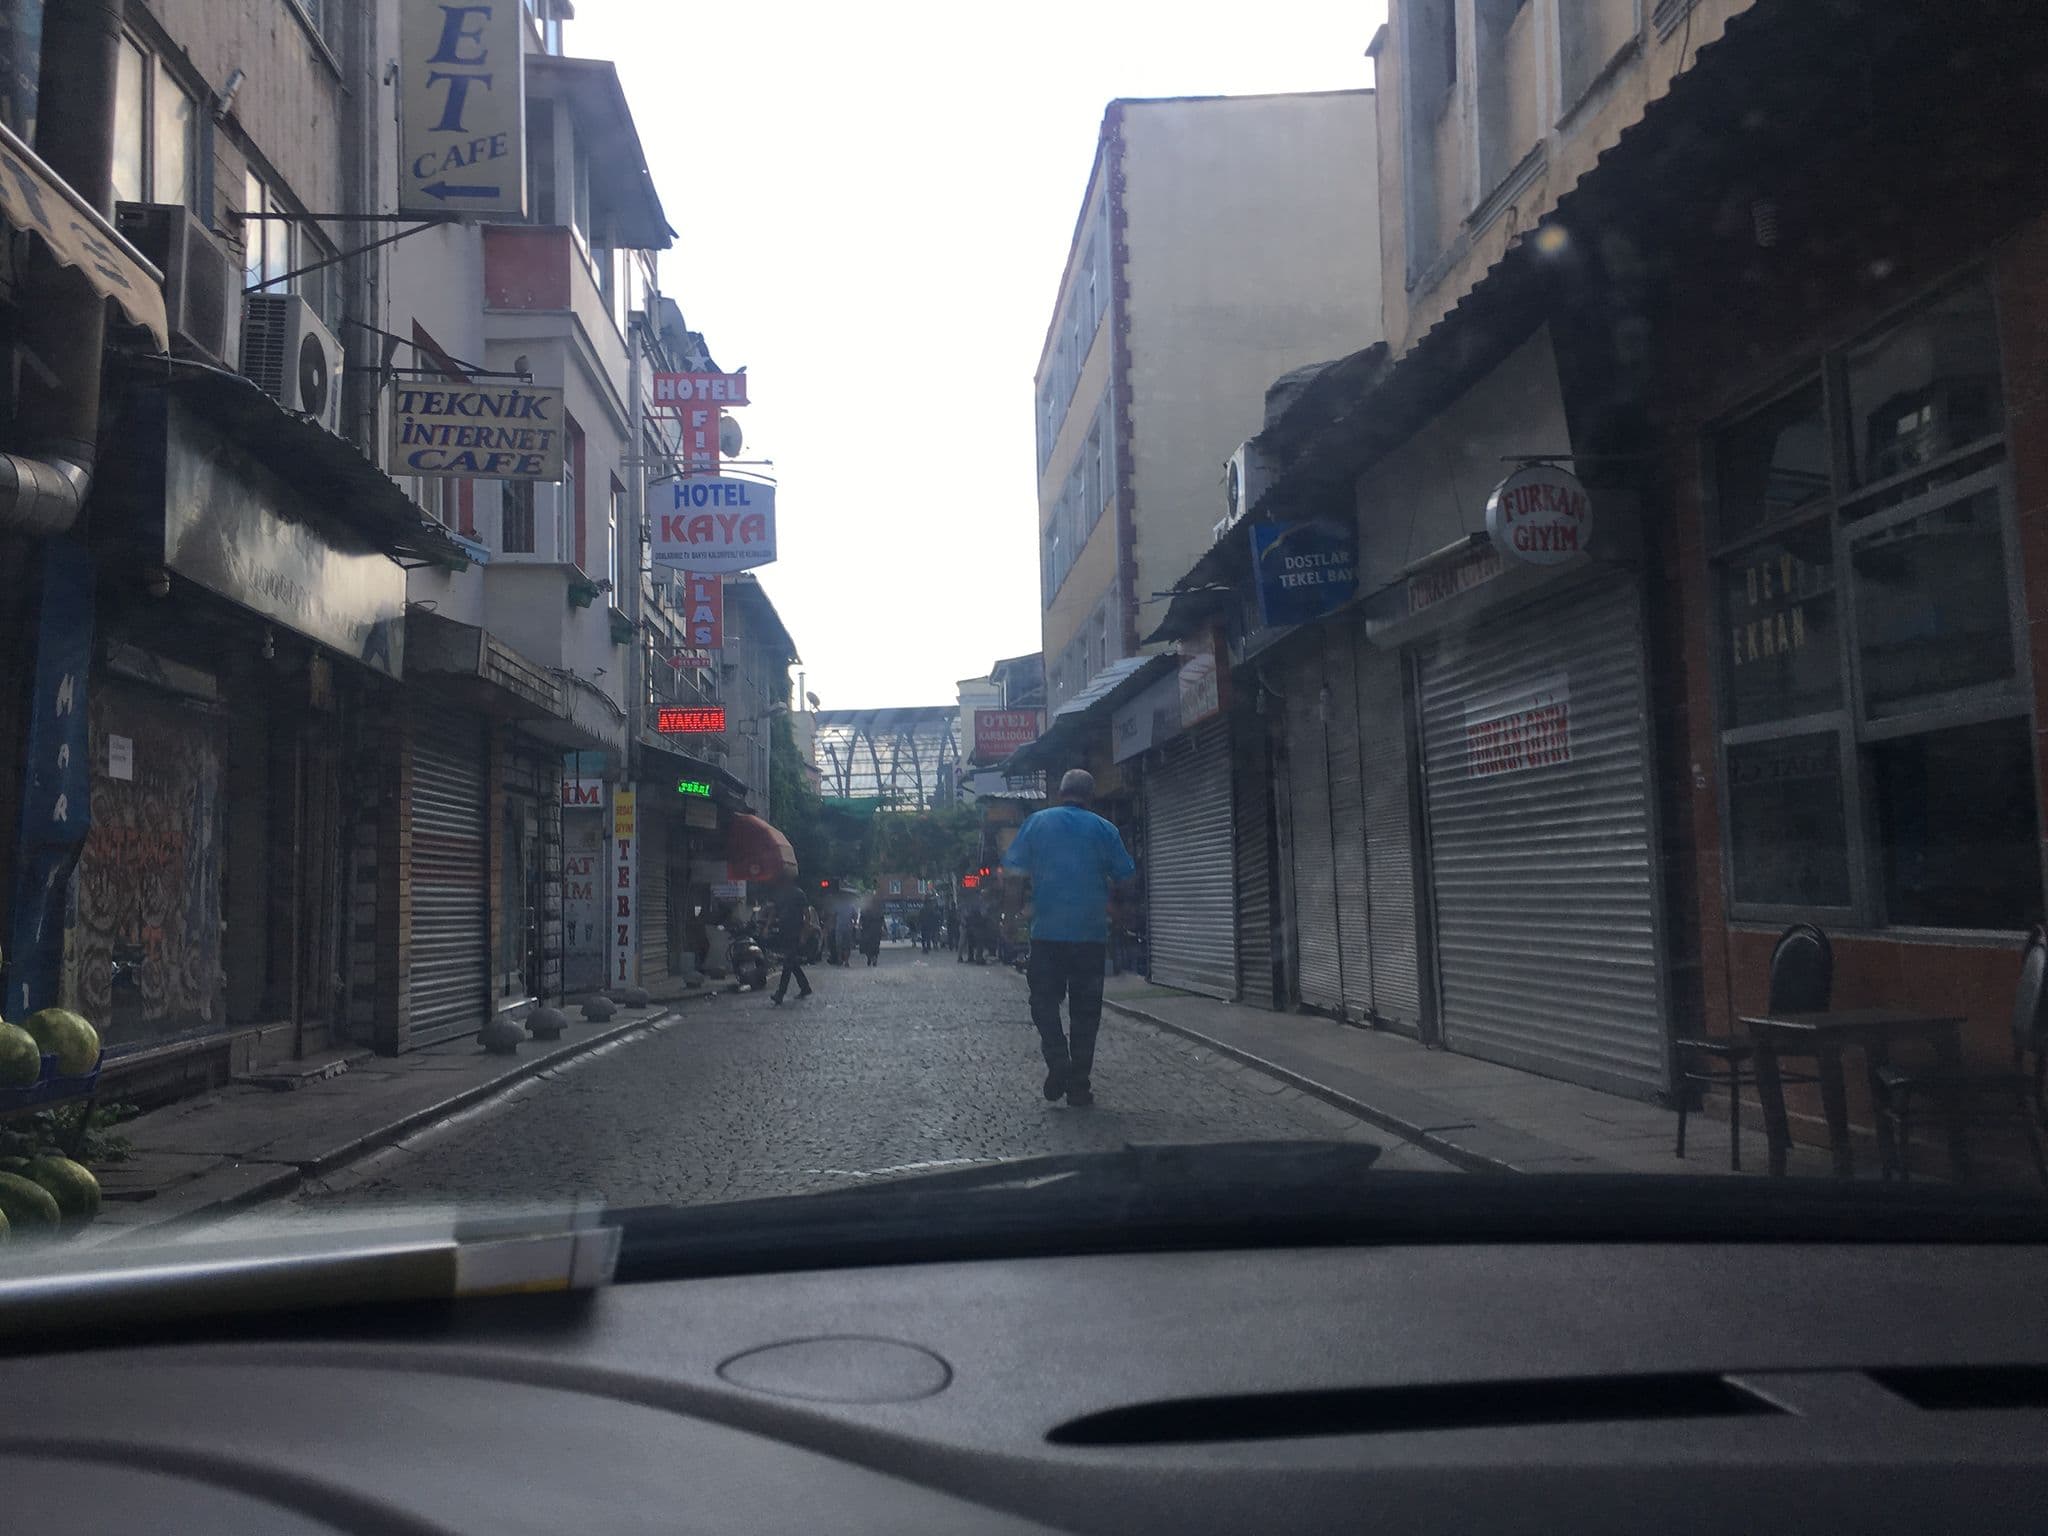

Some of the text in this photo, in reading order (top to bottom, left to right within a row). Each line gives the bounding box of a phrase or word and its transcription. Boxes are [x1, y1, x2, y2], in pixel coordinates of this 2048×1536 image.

[412, 132, 508, 179] CAFE
[656, 378, 744, 401] HOTEL
[399, 389, 552, 420] TEKNİK
[401, 416, 556, 451] İNTERNET
[407, 449, 546, 475] CAFE
[674, 483, 752, 509] HOTEL
[1500, 484, 1586, 523] FURKAN
[661, 514, 766, 545] KAYA
[1513, 520, 1579, 552] GİYİM
[1284, 551, 1349, 570] DOSTLAR
[1279, 570, 1325, 588] TEKEL
[659, 712, 725, 730] AYAKKABI
[983, 714, 1030, 728] OTEL
[617, 839, 630, 981] TERZİ
